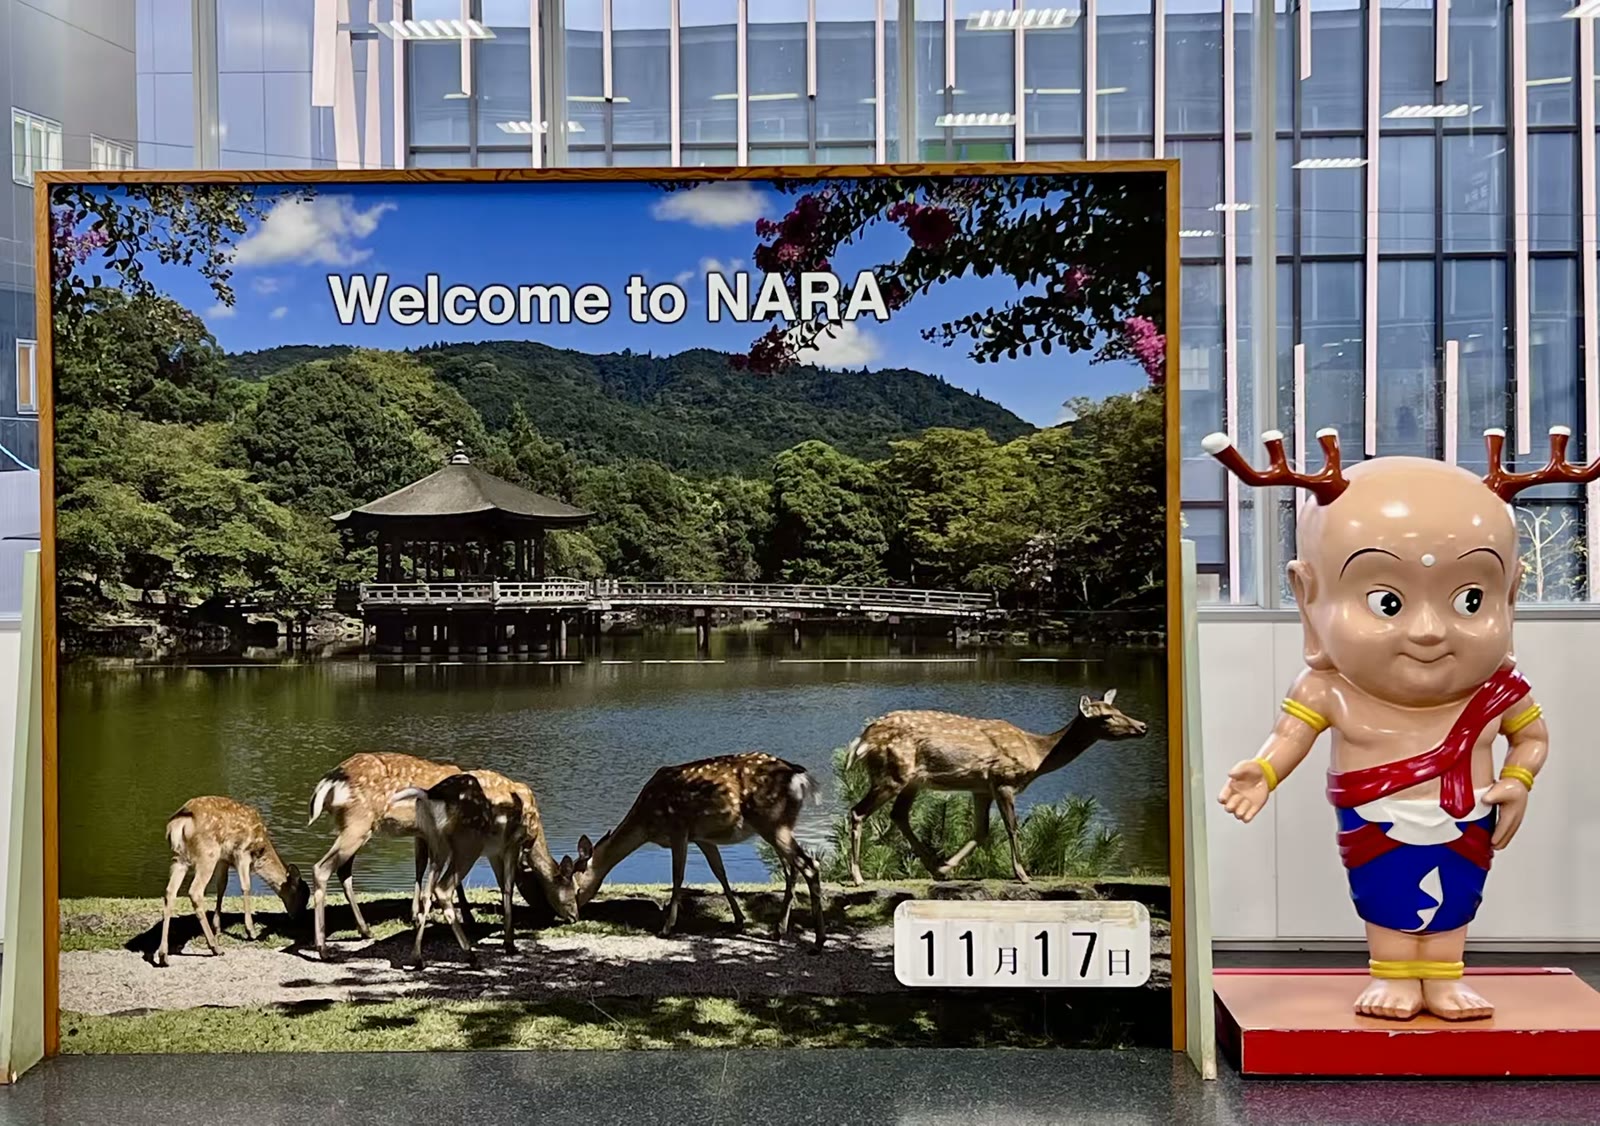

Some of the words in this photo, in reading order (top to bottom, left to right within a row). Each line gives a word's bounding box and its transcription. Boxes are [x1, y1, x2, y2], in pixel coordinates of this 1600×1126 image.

[327, 274, 610, 325] Welcome
[625, 276, 687, 323] to
[706, 270, 891, 322] NARA
[919, 930, 1131, 978] 11月17日
